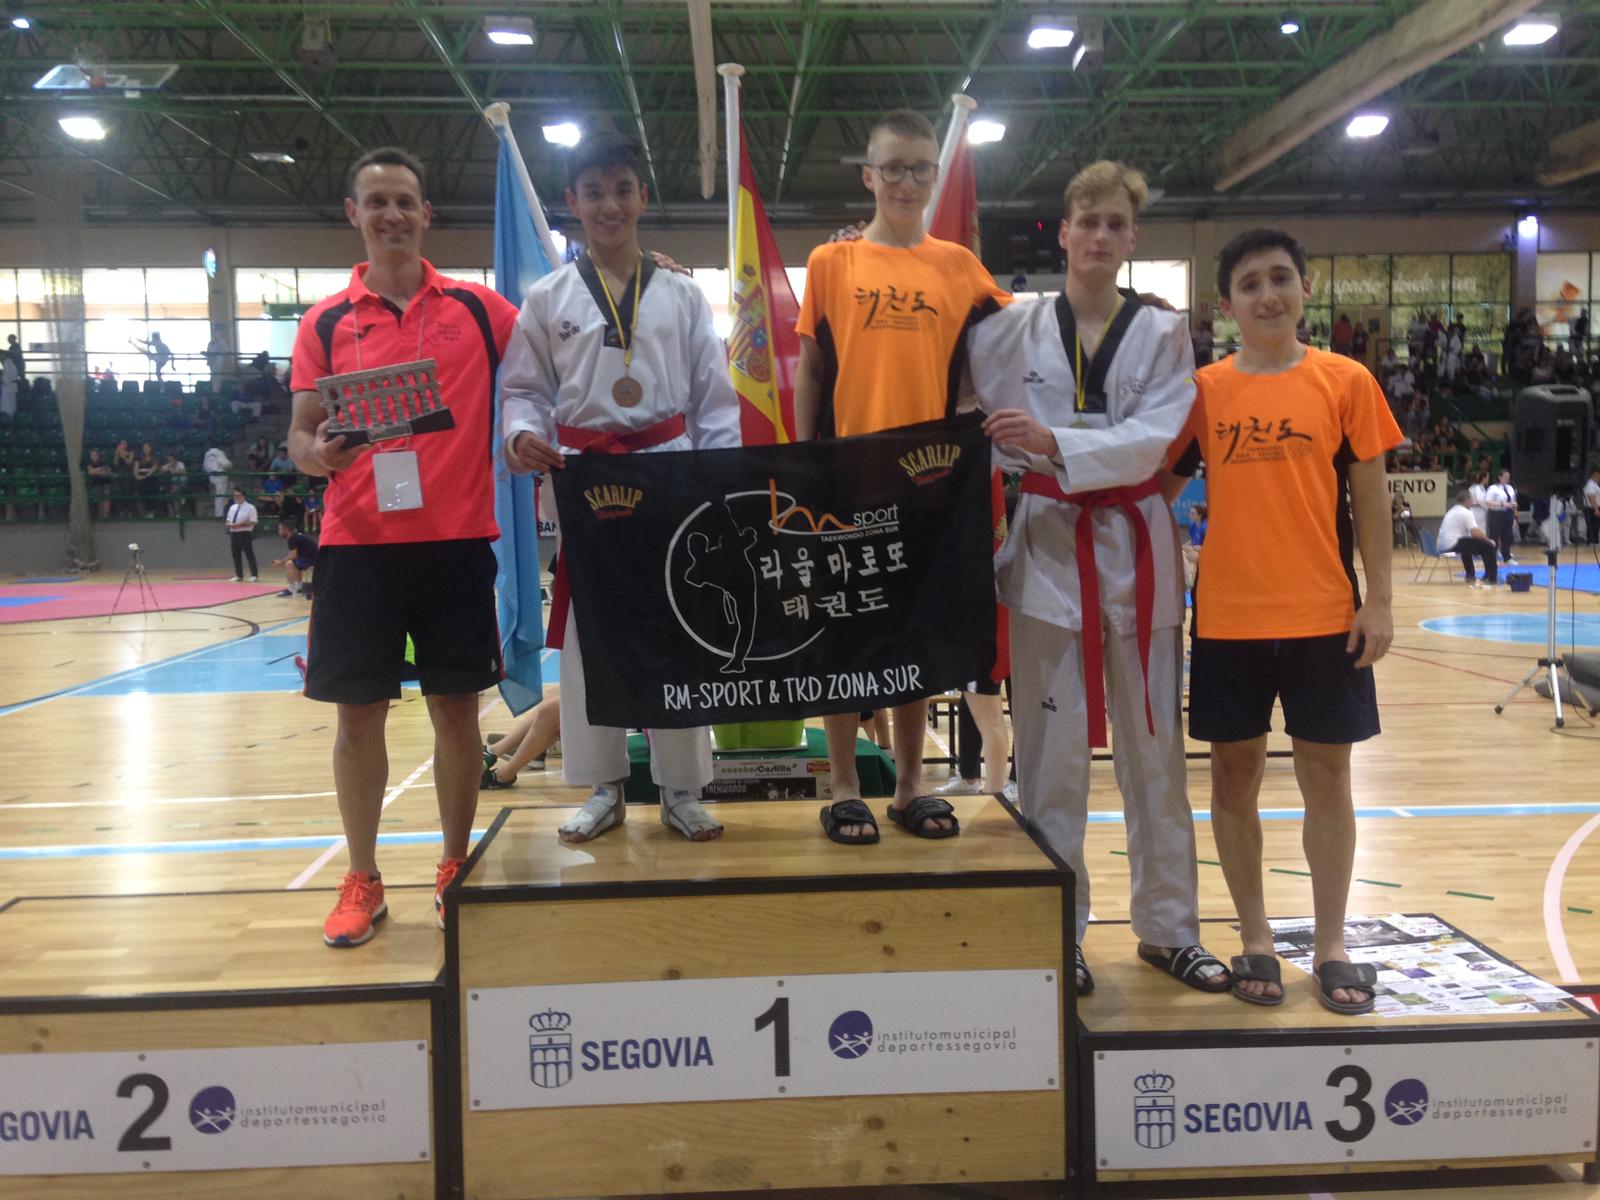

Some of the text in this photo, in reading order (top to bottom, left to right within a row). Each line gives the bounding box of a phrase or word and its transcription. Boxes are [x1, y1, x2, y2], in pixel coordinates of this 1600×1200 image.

[853, 503, 899, 528] sport
[663, 664, 924, 710] RM-SPORT & TKD ZONA SUR
[754, 997, 791, 1077] 1
[877, 1027, 1016, 1041] institutomunicipal
[877, 1040, 1017, 1055] deportessegovia
[580, 1035, 714, 1072] SEGOVIA
[116, 1073, 172, 1152] 2
[240, 1099, 386, 1116] institutomunicipal
[1183, 1100, 1313, 1134] SEGOVIA
[1324, 1064, 1376, 1143] 3
[1432, 1105, 1567, 1121] deportessegovia
[0, 1110, 95, 1142] GOVIA
[240, 1113, 387, 1129] deportessegovia
